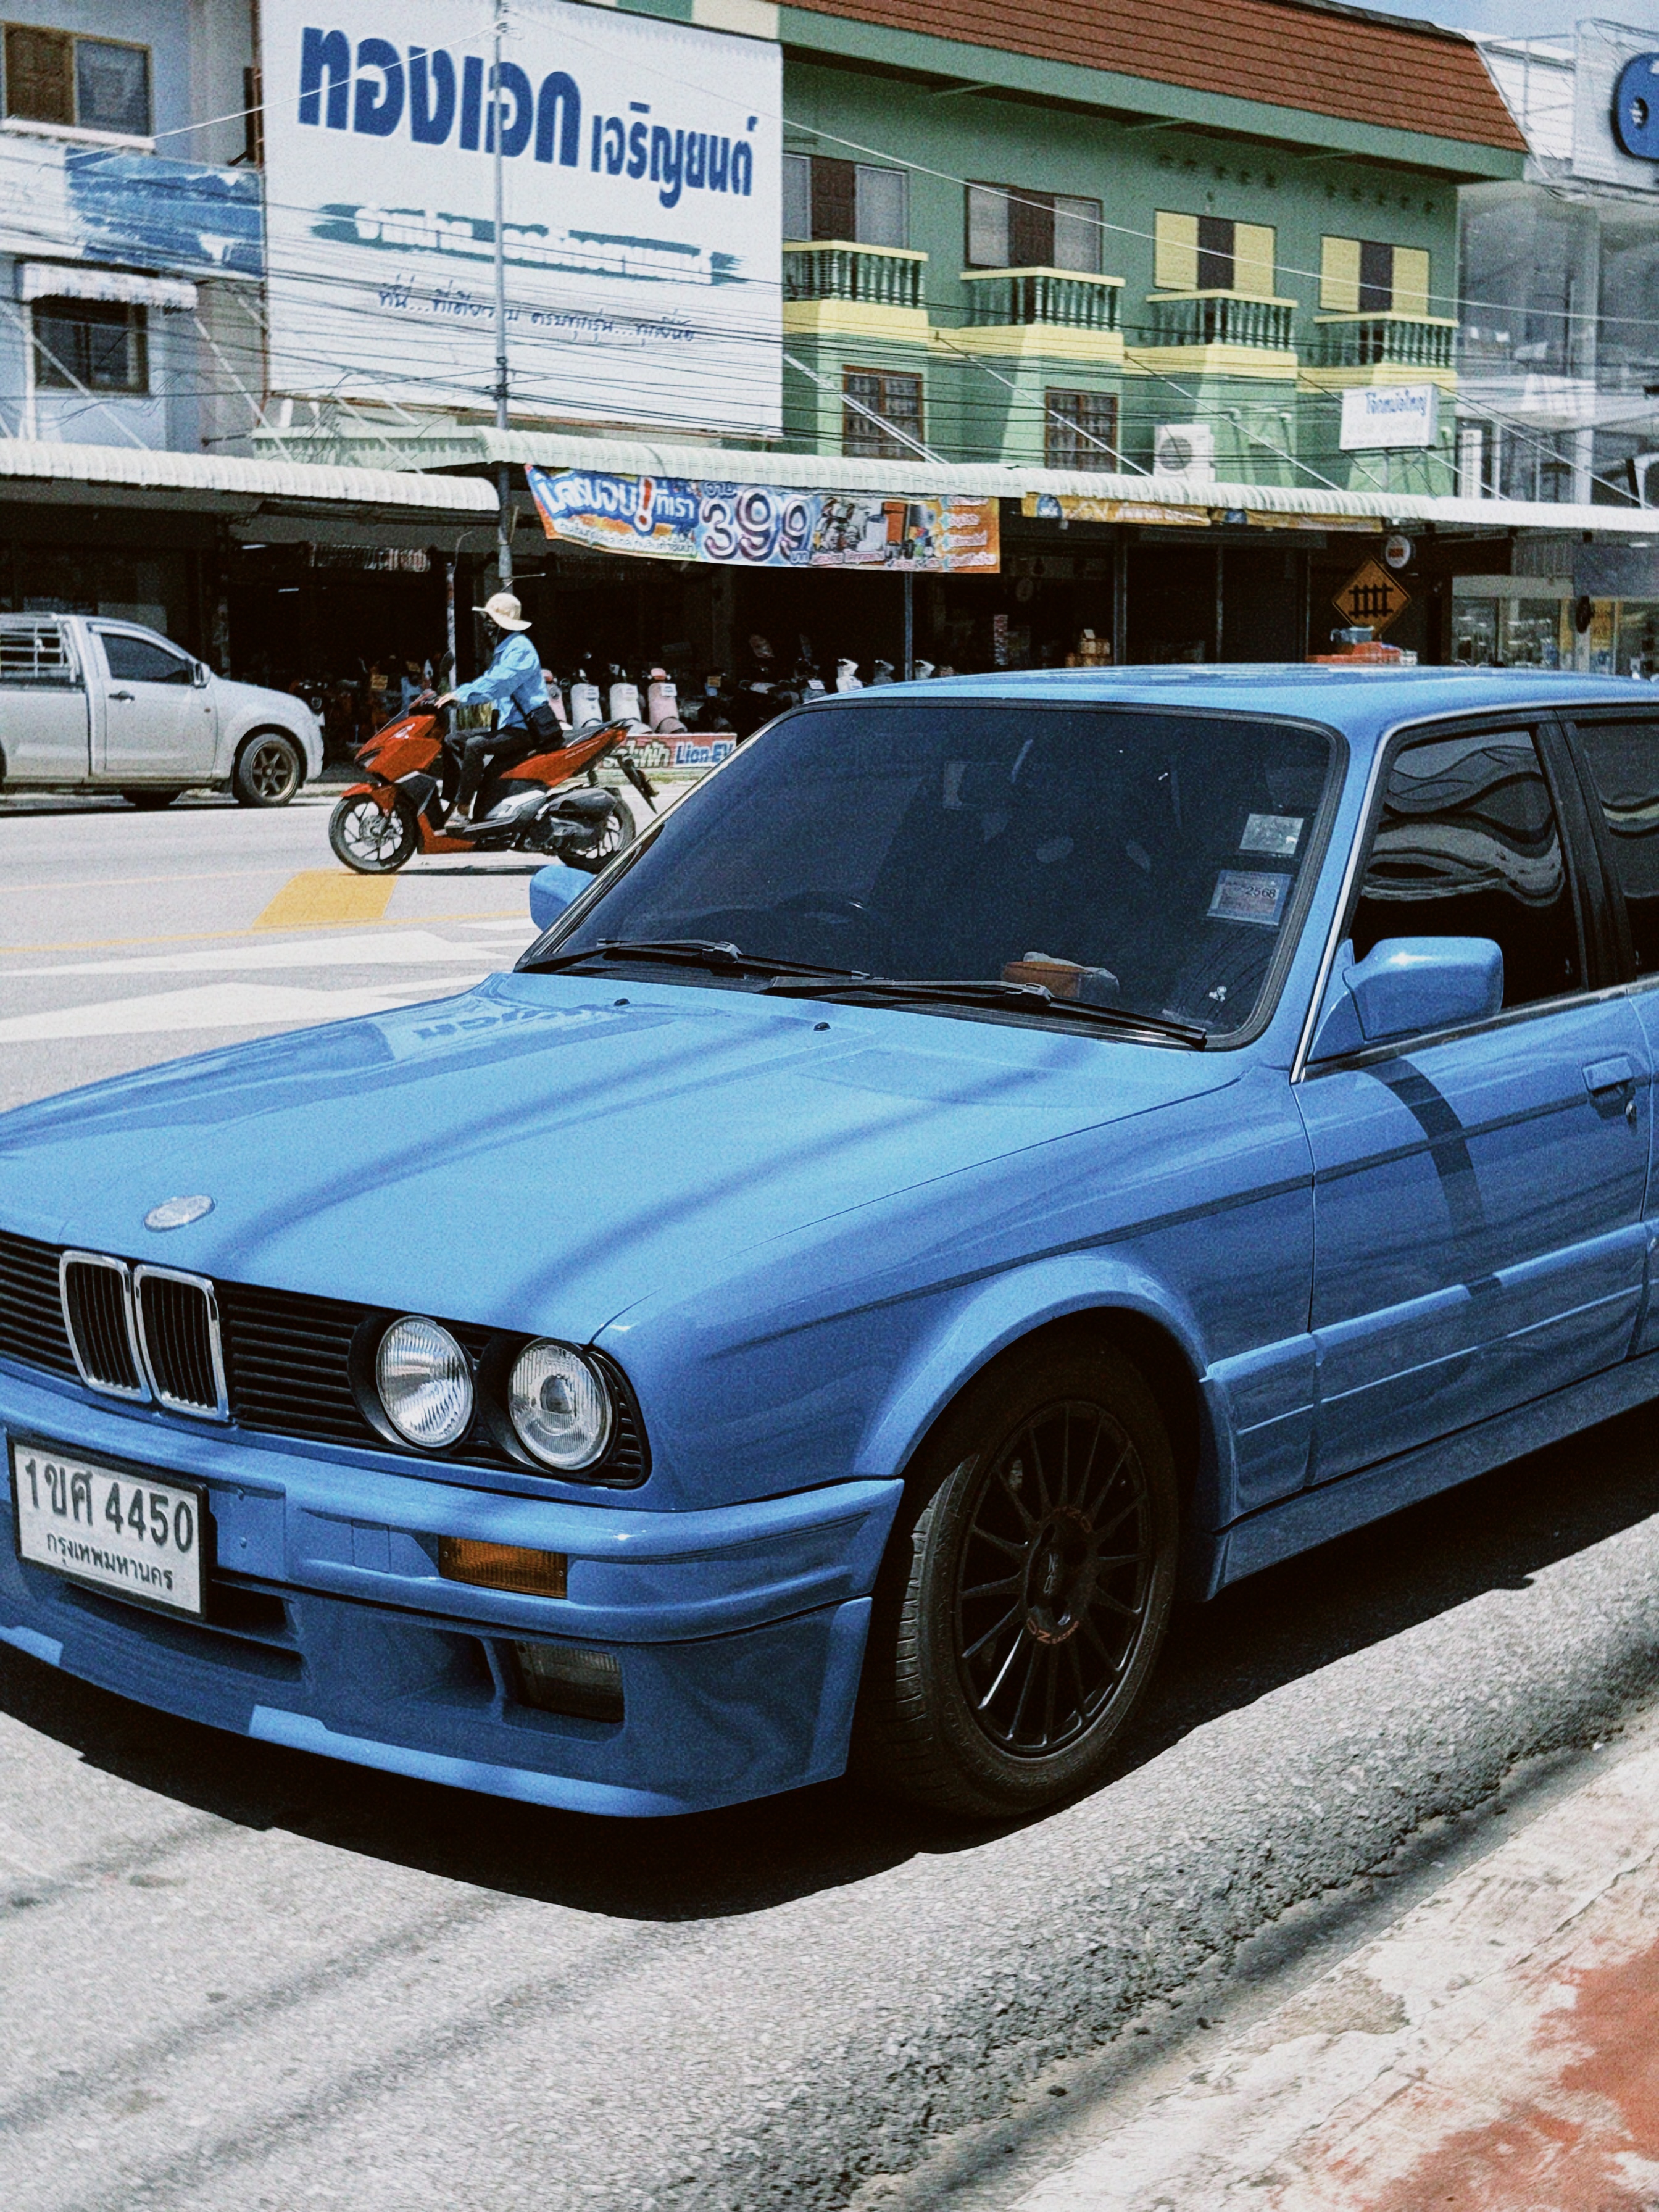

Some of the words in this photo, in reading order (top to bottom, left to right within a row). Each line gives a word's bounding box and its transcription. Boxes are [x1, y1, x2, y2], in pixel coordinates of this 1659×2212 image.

[298, 27, 581, 167] ทองเอก
[591, 101, 759, 209] เจริญยนต์
[699, 486, 809, 563] 399
[1245, 886, 1277, 899] 2568
[25, 1458, 94, 1526] 1ขศ
[105, 1482, 194, 1553] 4450
[47, 1532, 173, 1592] กรุงเทพมหานคร
